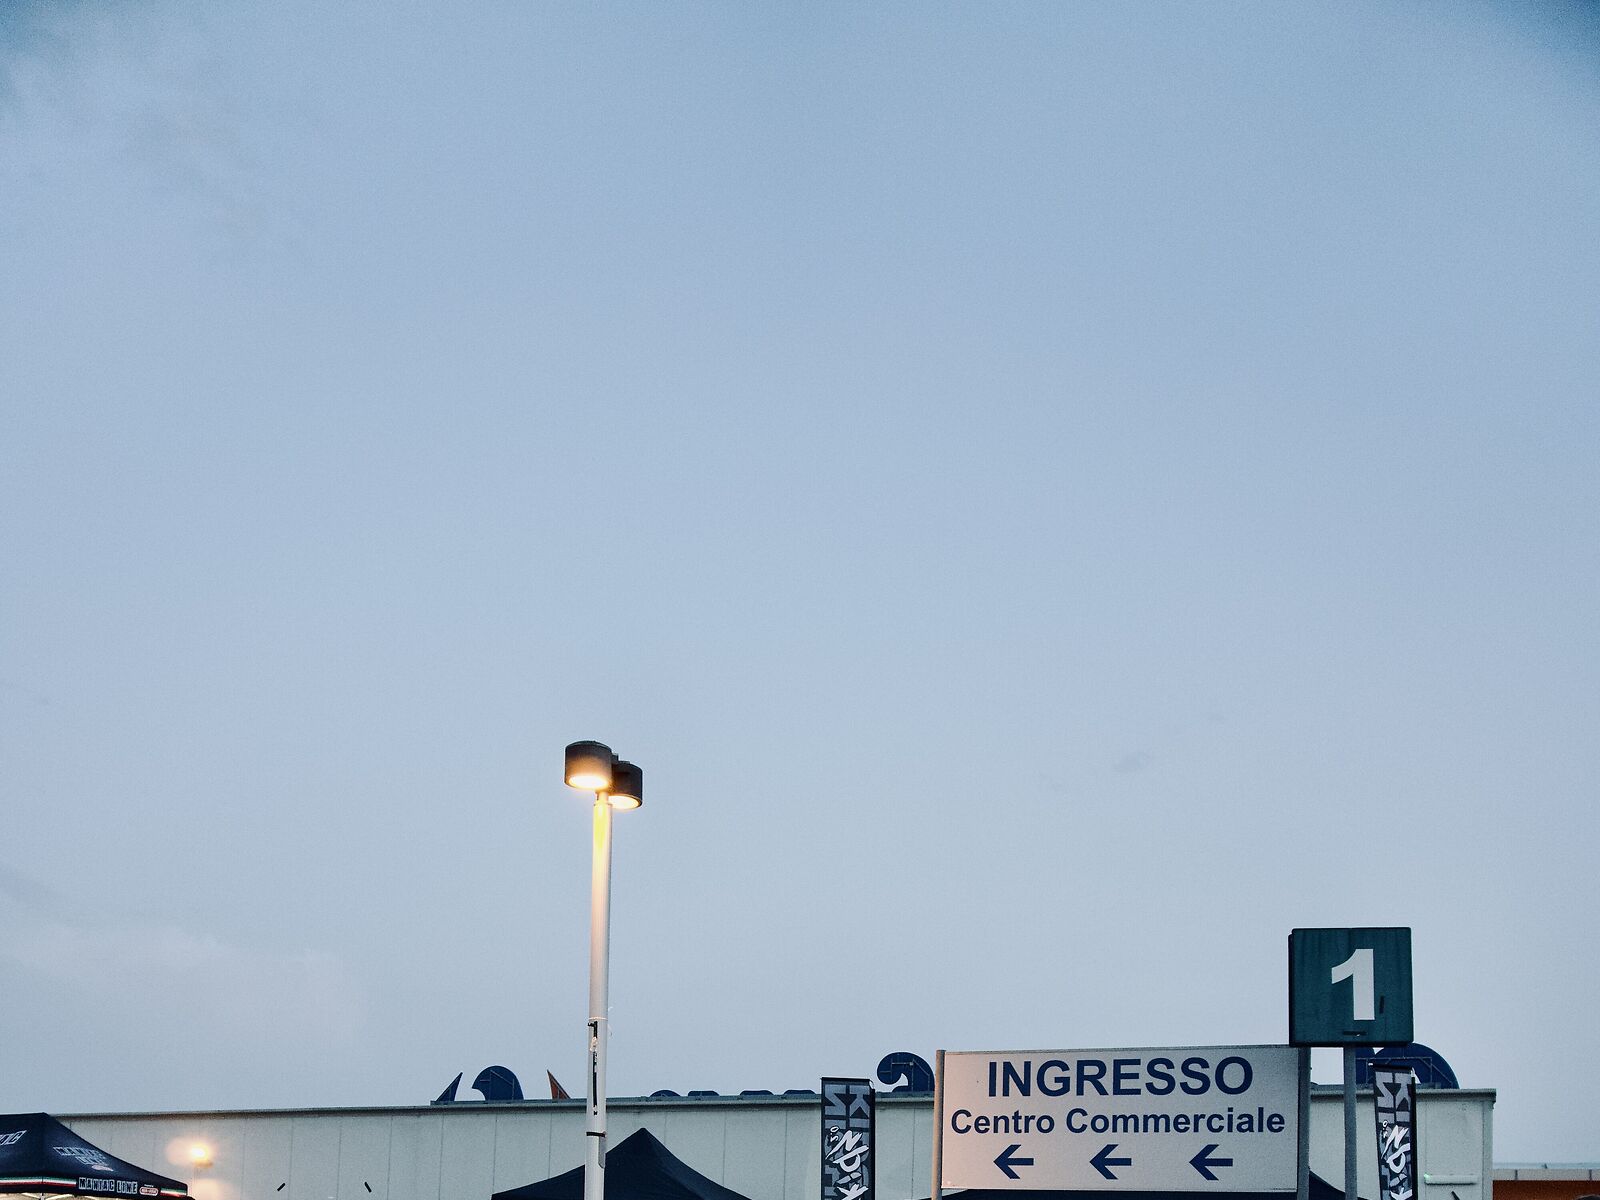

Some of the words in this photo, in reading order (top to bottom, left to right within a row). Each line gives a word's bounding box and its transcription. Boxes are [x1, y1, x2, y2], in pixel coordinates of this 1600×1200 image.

[1331, 948, 1376, 1021] 1
[988, 1056, 1254, 1098] INGRESSO
[951, 1109, 1056, 1134] Centro
[1066, 1106, 1286, 1134] Commerciale
